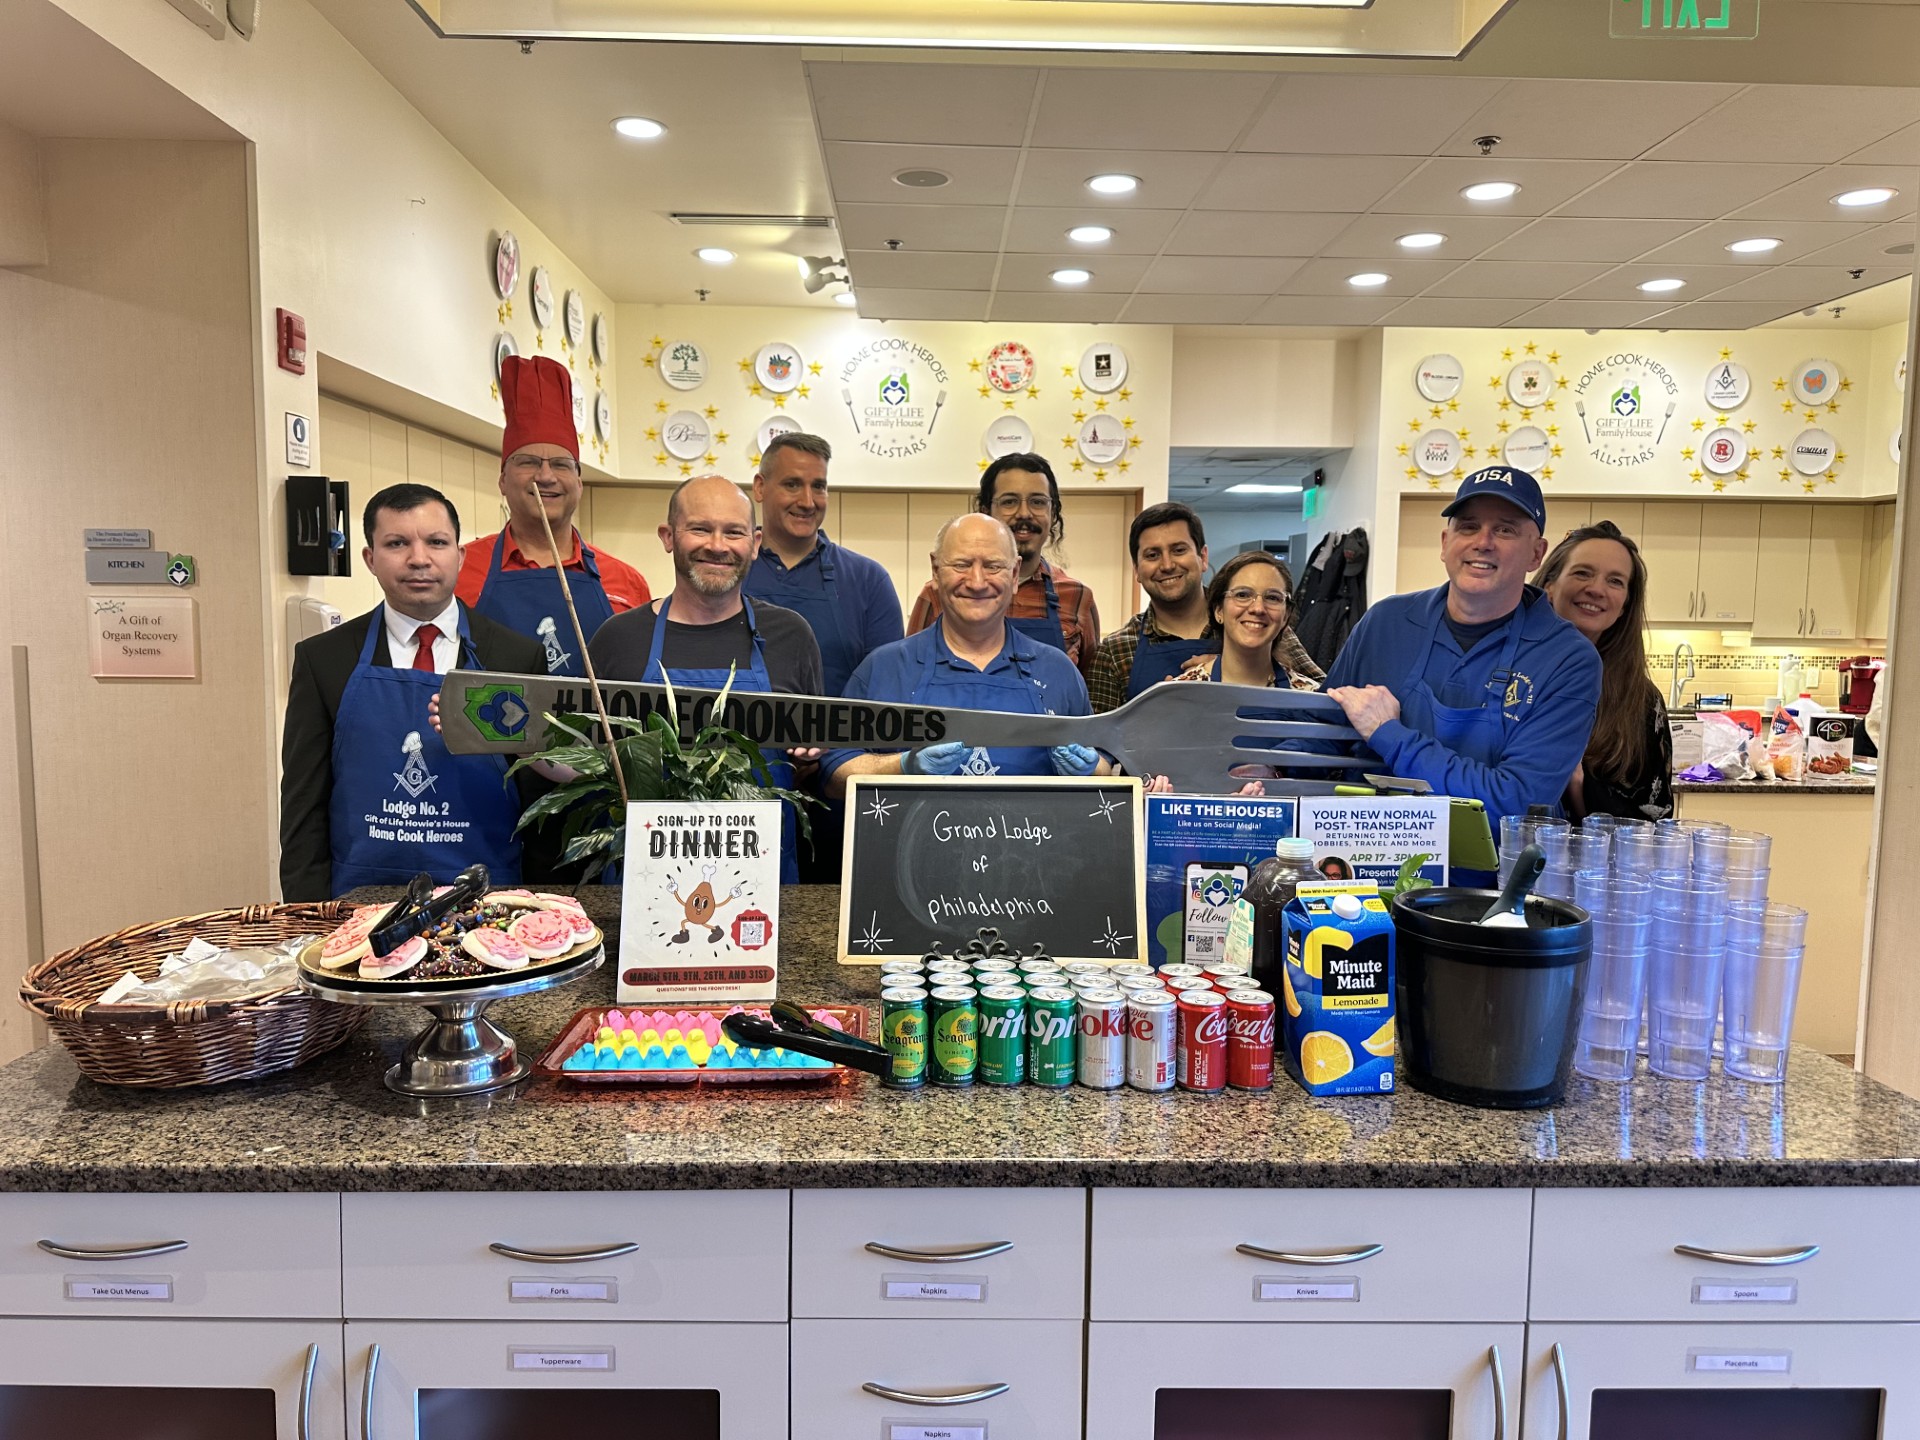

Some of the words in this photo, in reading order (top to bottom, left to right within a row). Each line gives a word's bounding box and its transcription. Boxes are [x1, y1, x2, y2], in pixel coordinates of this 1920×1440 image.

[840, 346, 871, 383] HOME
[871, 339, 909, 353] COOK
[911, 343, 949, 383] HEROES
[1574, 361, 1606, 395] HOME
[1606, 353, 1643, 367] COOK
[1644, 358, 1679, 395] HEROES
[864, 407, 890, 417] GIFT
[900, 407, 925, 417] LIFE
[864, 418, 894, 429] Family
[896, 418, 924, 427] House
[1596, 418, 1623, 428] GIFT
[1630, 419, 1653, 428] LIFE
[1596, 428, 1625, 439] Family
[1626, 428, 1653, 437] House
[1474, 470, 1513, 486] USA
[107, 560, 145, 569] KITCHEN
[118, 616, 127, 625] A
[129, 615, 149, 625] Gift
[151, 615, 162, 625] of
[102, 630, 132, 642] Organ
[134, 630, 178, 642] Recovery
[122, 645, 161, 656] Systems
[383, 799, 416, 819] Lodge
[419, 801, 439, 815] No.
[441, 801, 450, 815] 2
[1161, 803, 1192, 815] LIKE
[1194, 804, 1223, 816] THE
[1226, 805, 1283, 818] HOUSE?
[1312, 810, 1347, 820] YOUR
[1350, 810, 1381, 820] NEW
[1384, 810, 1437, 820] NORMAL
[364, 814, 379, 824] Gift
[379, 816, 388, 825] of
[388, 817, 404, 827] Life
[405, 819, 441, 828] Howie's
[442, 820, 470, 828] House
[657, 815, 706, 827] SIGN-UP
[709, 815, 722, 827] TO
[726, 815, 756, 827] COOK
[1214, 821, 1235, 829] Social
[1236, 822, 1262, 830] Media!
[1314, 821, 1351, 831] POST-
[1354, 821, 1435, 831] TRANSPLANT
[932, 810, 998, 843] Grand
[1001, 815, 1052, 846] Lodge
[369, 825, 395, 840] Home
[397, 828, 425, 843] Cook
[426, 829, 464, 843] Heroes
[1392, 832, 1422, 840] WORK,
[649, 829, 760, 859] DINNER
[1349, 853, 1372, 862] APR
[1374, 853, 1386, 862] 17
[972, 855, 989, 873] of
[1358, 868, 1402, 877] Presente
[1189, 907, 1228, 923] Follow
[1329, 959, 1383, 974] Minute
[629, 972, 660, 982] MARCH
[729, 969, 746, 980] AND
[749, 969, 769, 980] 31ST
[1336, 974, 1375, 989] Maid
[1333, 997, 1379, 1006] Lemonade
[1194, 1049, 1202, 1086] RECYCLE
[1201, 1073, 1208, 1087] ME
[92, 1287, 109, 1296] Take
[110, 1287, 124, 1296] Out
[125, 1287, 149, 1296] Menus
[550, 1287, 570, 1296] Forks
[920, 1286, 948, 1297] Napkins
[1296, 1287, 1319, 1296] Knives
[1733, 1290, 1758, 1298] Spoons
[540, 1357, 582, 1367] Tupperware
[924, 1430, 951, 1440] Napkins
